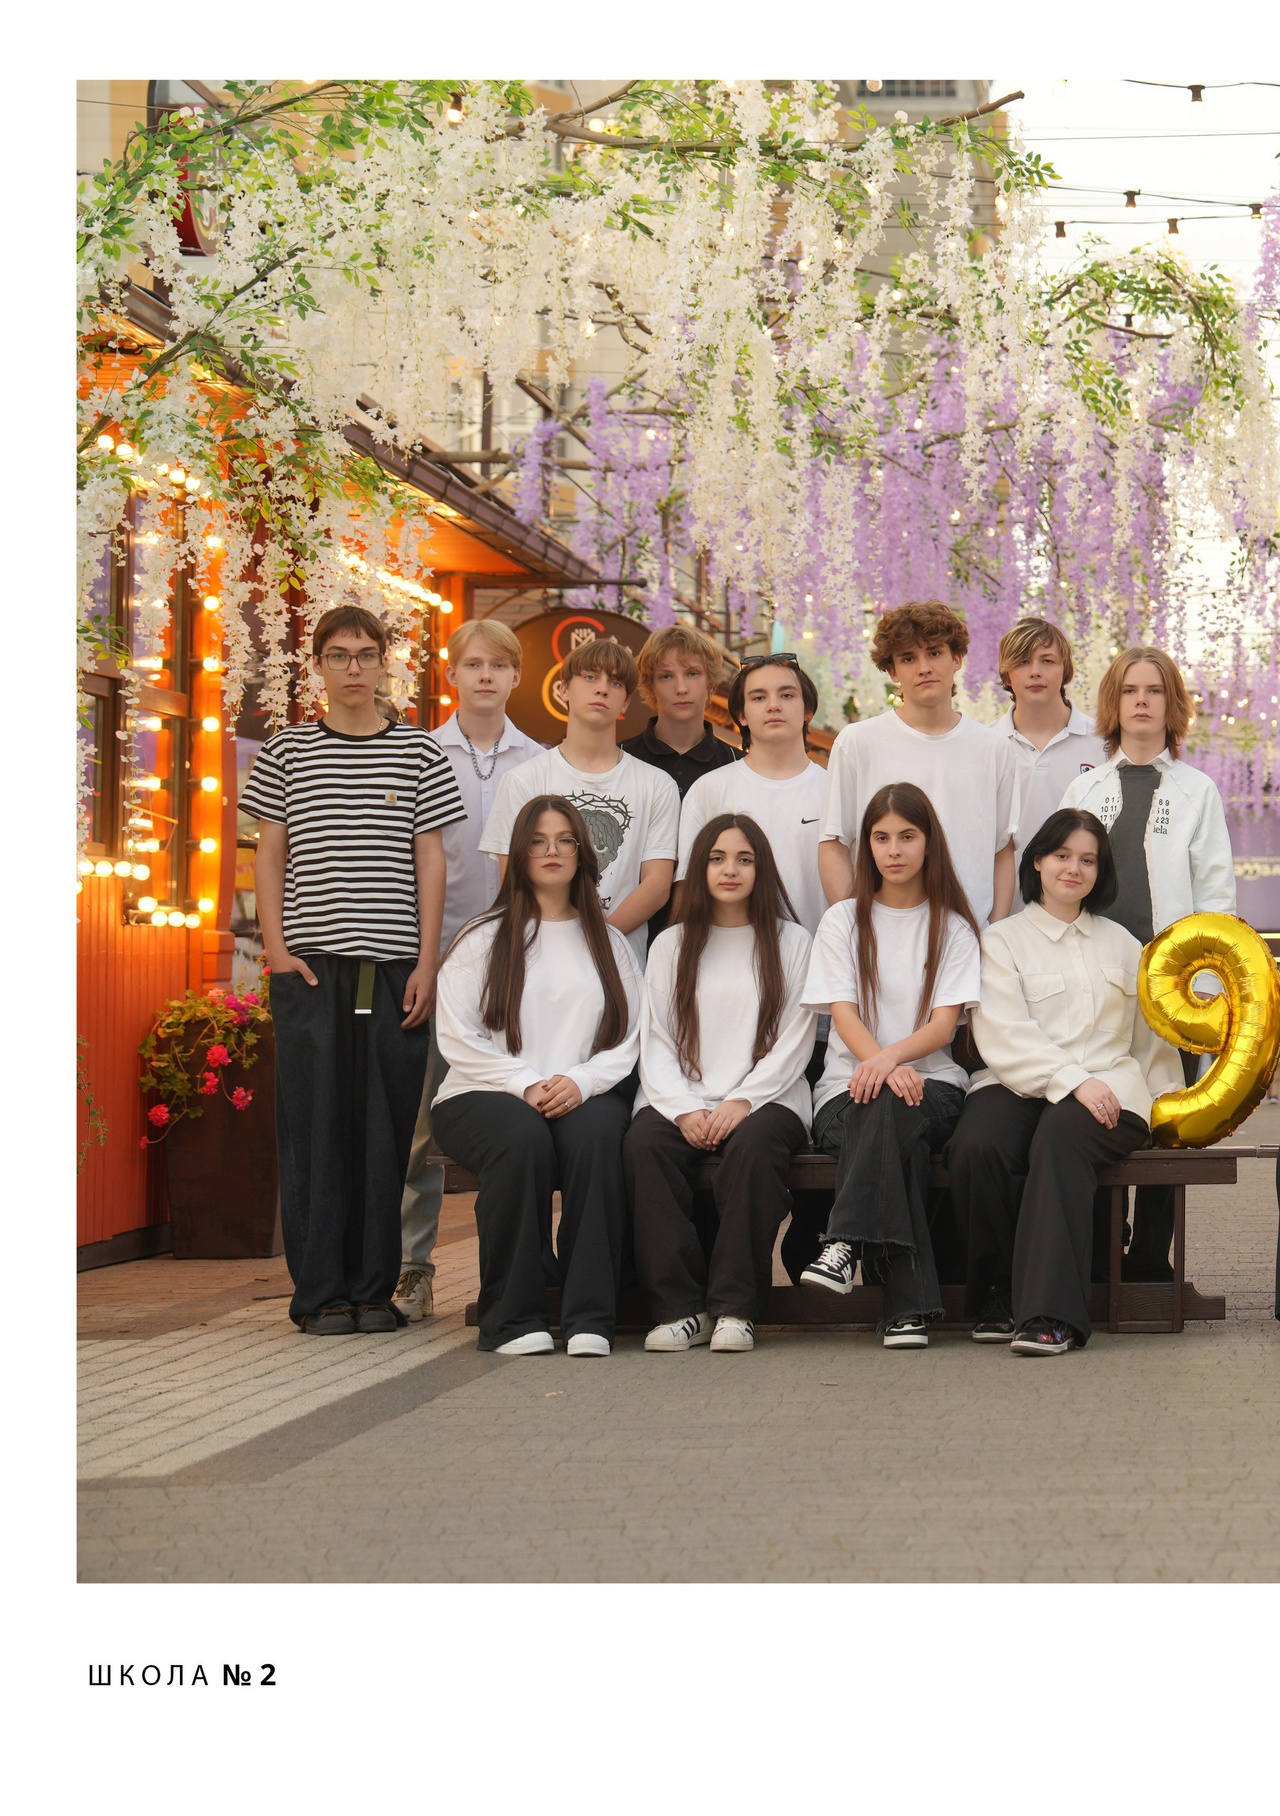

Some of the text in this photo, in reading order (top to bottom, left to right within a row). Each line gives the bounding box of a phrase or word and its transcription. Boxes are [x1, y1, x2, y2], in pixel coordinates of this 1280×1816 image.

[1165, 799, 1170, 807] 9
[1162, 808, 1170, 816] 16
[1161, 817, 1170, 825] 23
